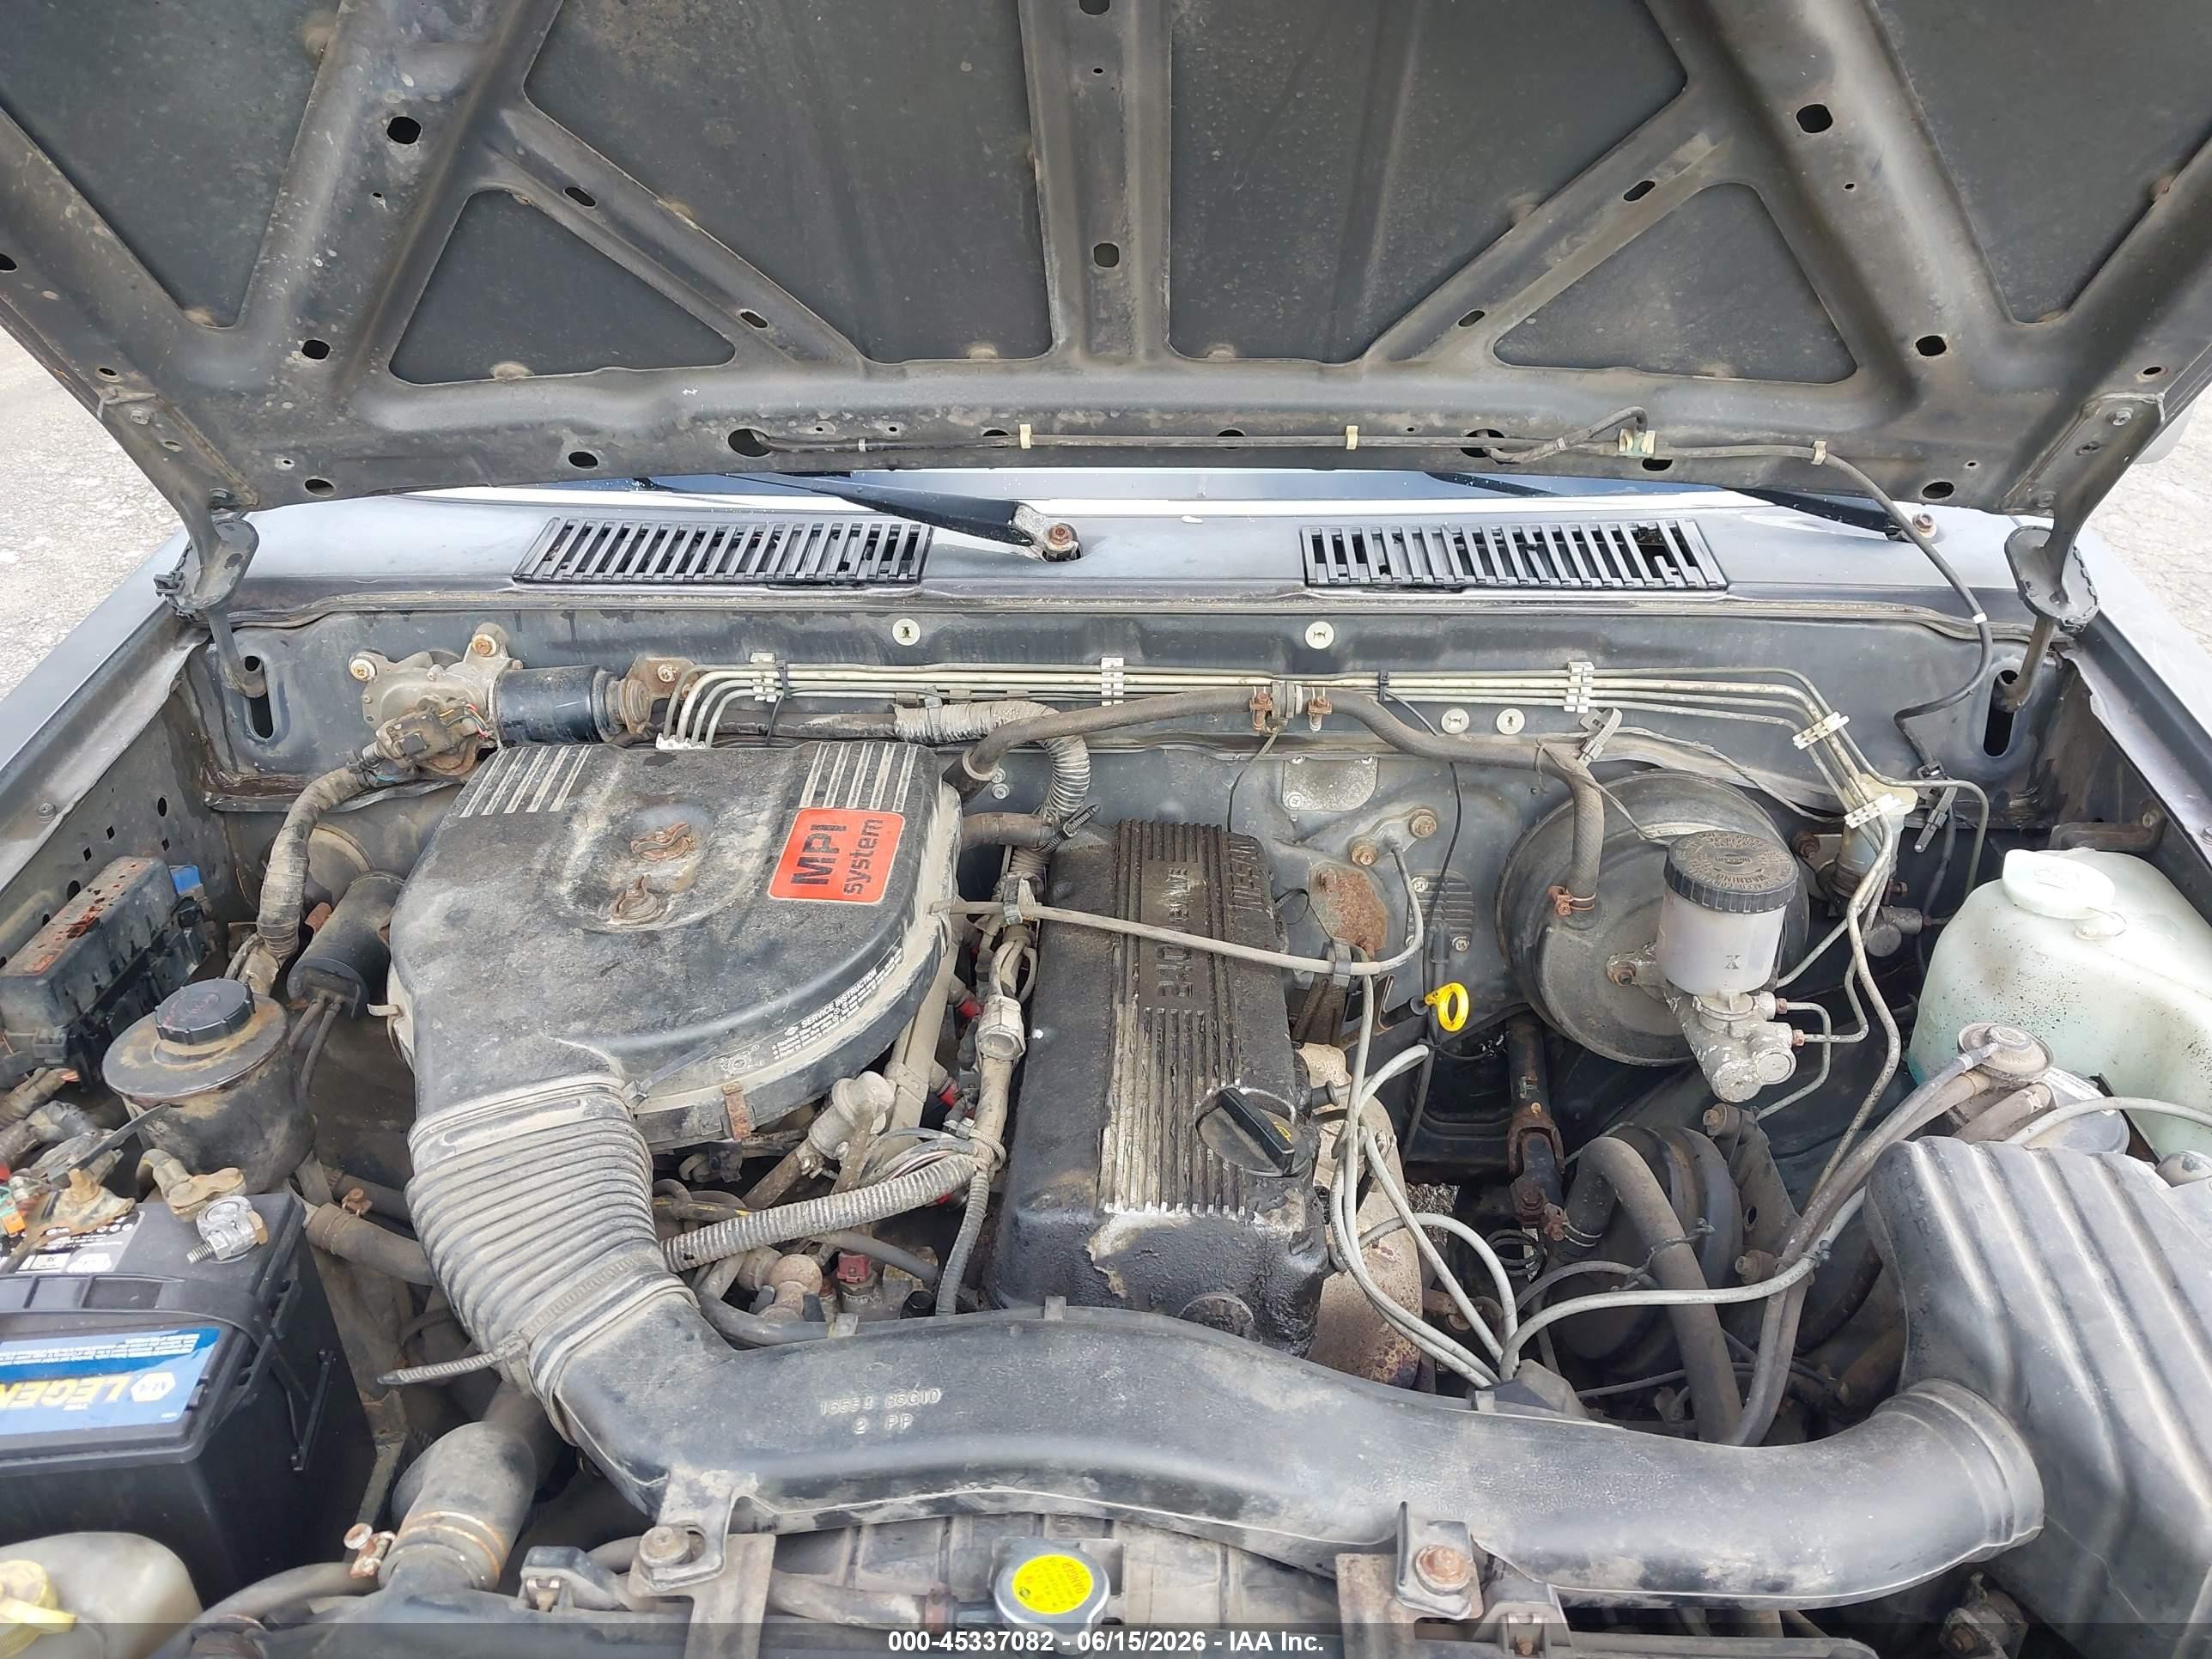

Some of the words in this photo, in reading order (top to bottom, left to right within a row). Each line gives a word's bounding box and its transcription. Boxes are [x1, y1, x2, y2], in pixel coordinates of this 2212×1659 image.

[790, 823, 848, 885] MPI
[843, 818, 885, 895] system
[800, 1002, 835, 1029] SERVICE
[835, 968, 878, 1007] INSTRUCTION
[852, 1416, 867, 1435] 2
[884, 1413, 914, 1431] PP
